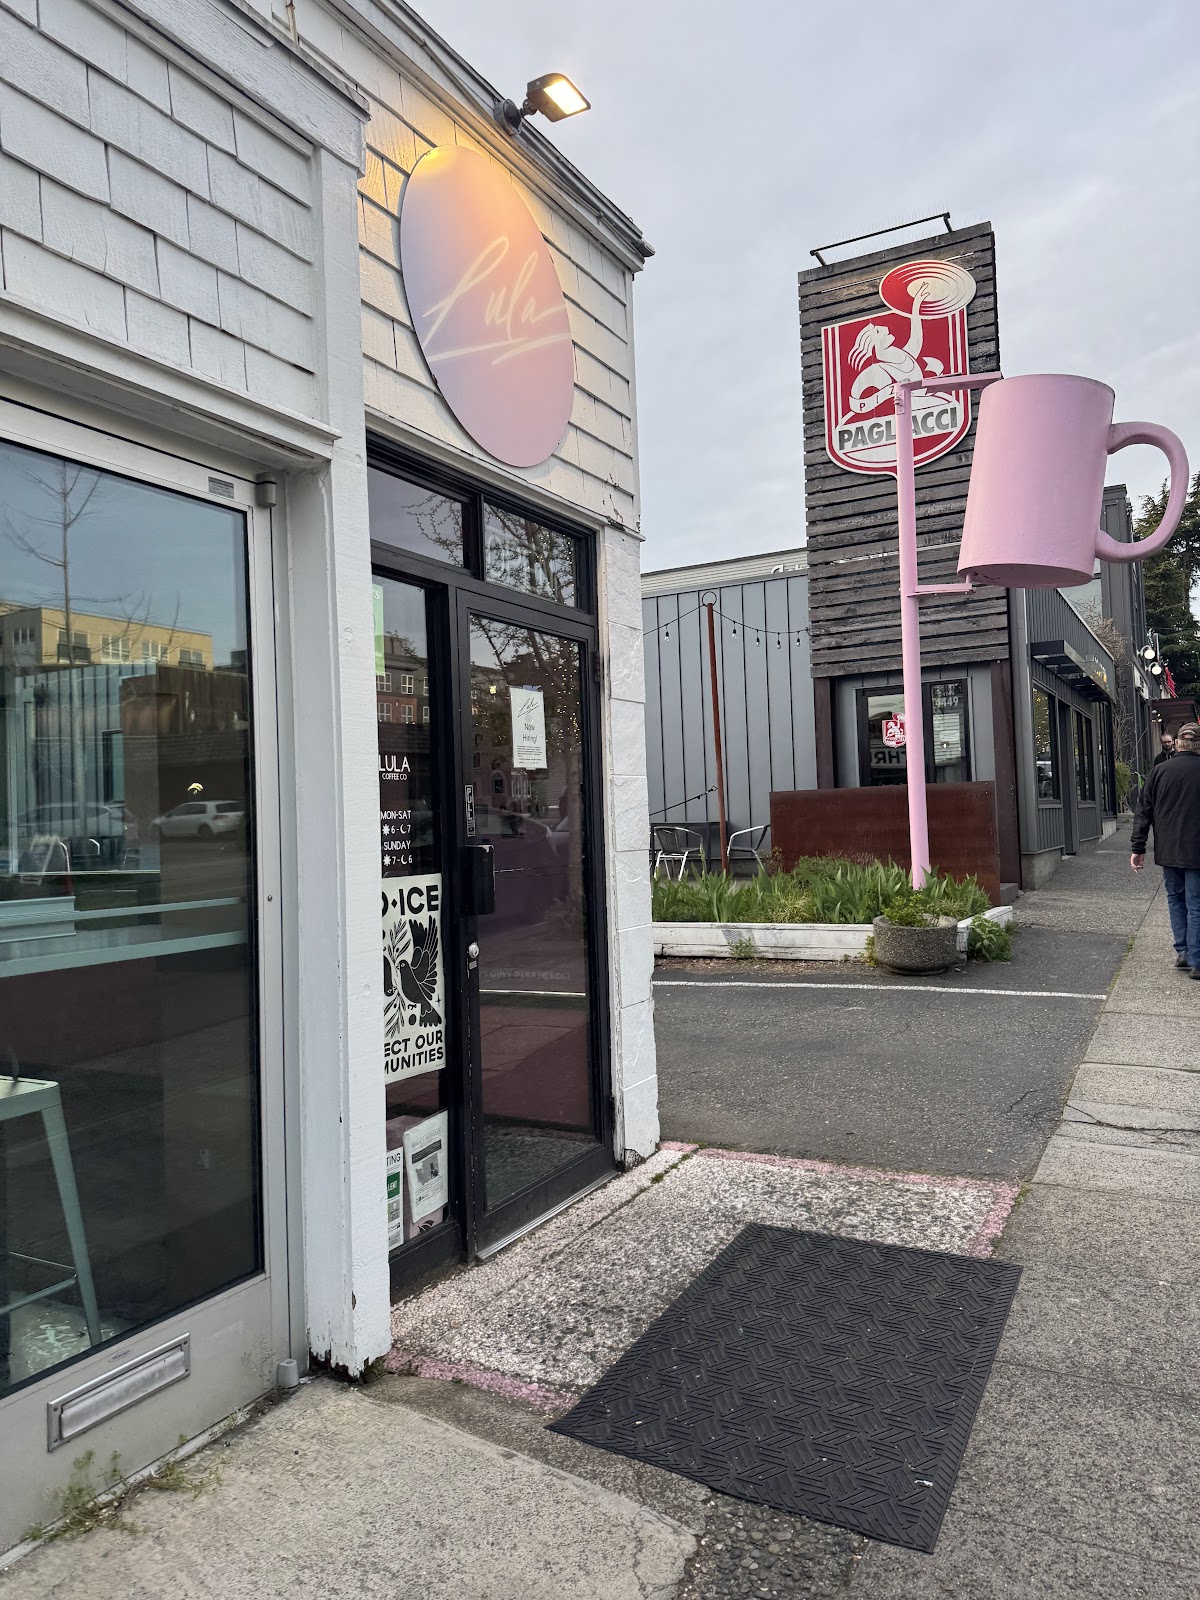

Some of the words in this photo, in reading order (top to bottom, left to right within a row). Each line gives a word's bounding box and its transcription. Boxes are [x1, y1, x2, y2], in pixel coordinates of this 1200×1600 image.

[838, 406, 958, 451] PAGLACCI
[378, 755, 411, 773] LULA
[382, 773, 399, 781] COFFEE
[380, 810, 412, 820] MON-SAT
[383, 840, 411, 850] SUNDAY
[415, 1030, 444, 1050] OUR
